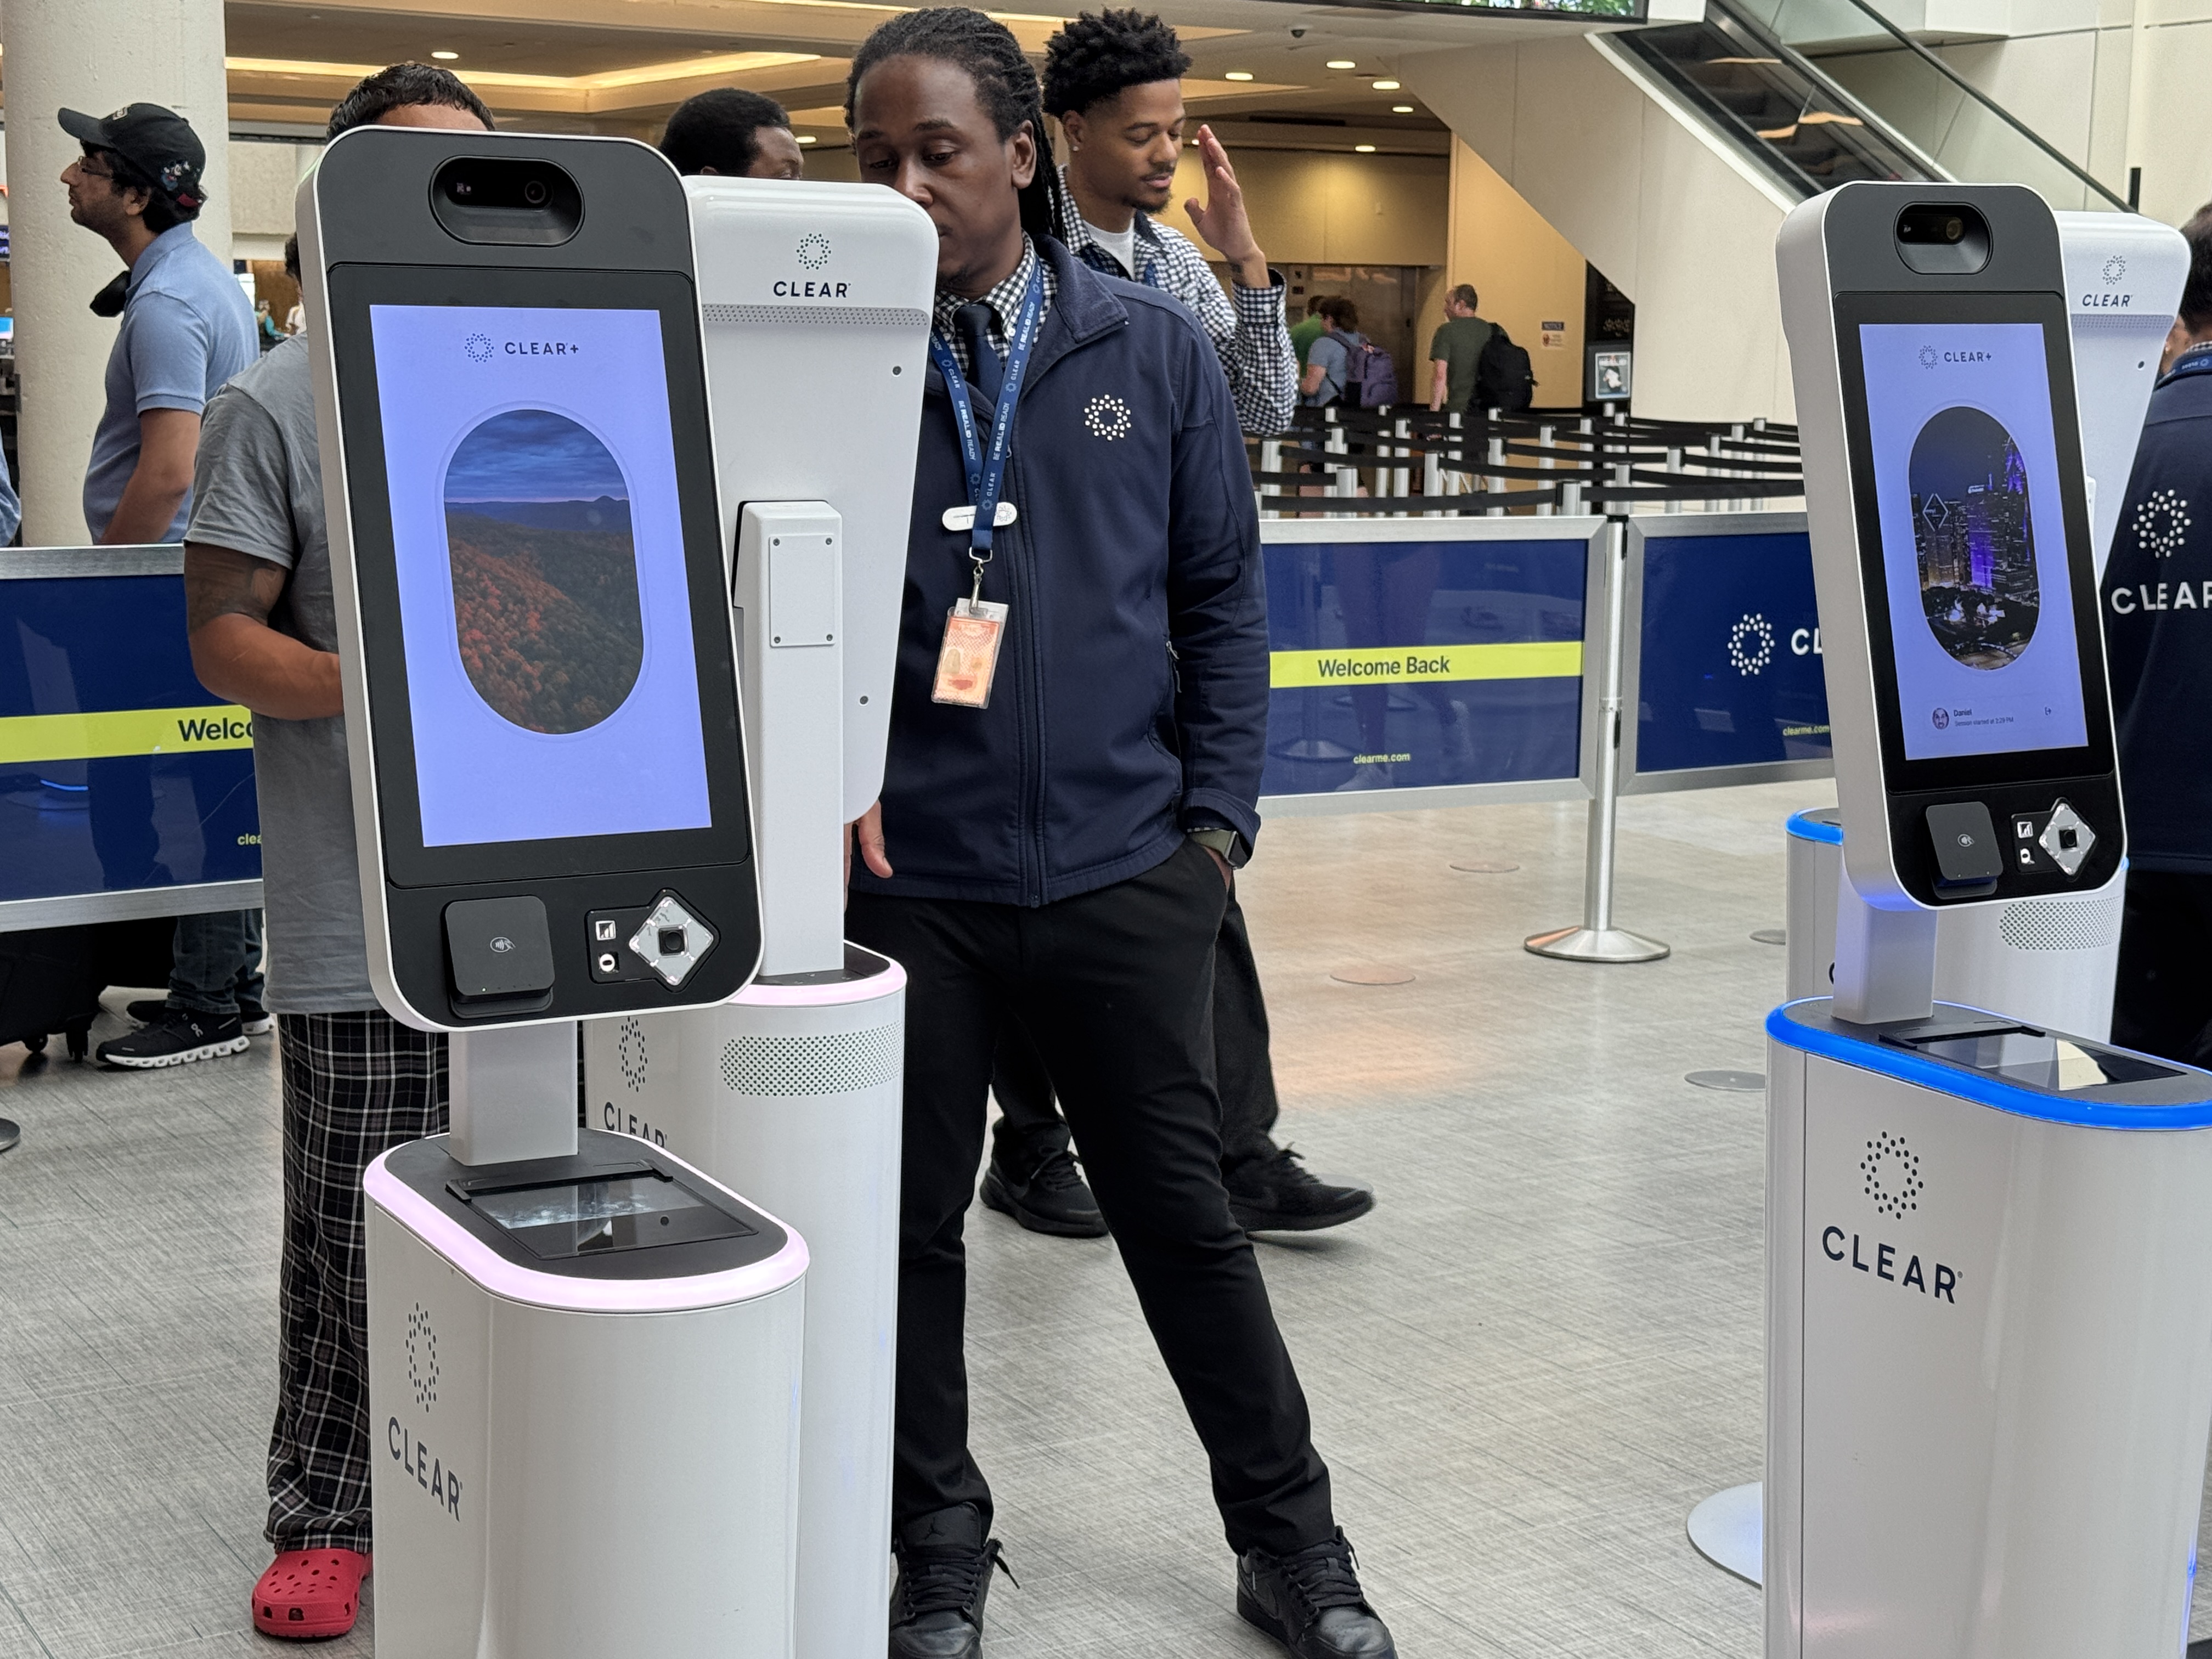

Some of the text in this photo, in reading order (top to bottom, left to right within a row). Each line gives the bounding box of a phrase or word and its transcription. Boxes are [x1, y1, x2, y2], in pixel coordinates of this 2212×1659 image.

[773, 281, 848, 298] CLEAR
[2082, 294, 2131, 307] CLEAR
[995, 432, 1005, 452] REAL
[1318, 656, 1451, 678] Welcome Back
[1353, 753, 1411, 764] clearme.com
[1822, 1226, 1959, 1304] CLEAR
[388, 1416, 461, 1522] CLEAR
